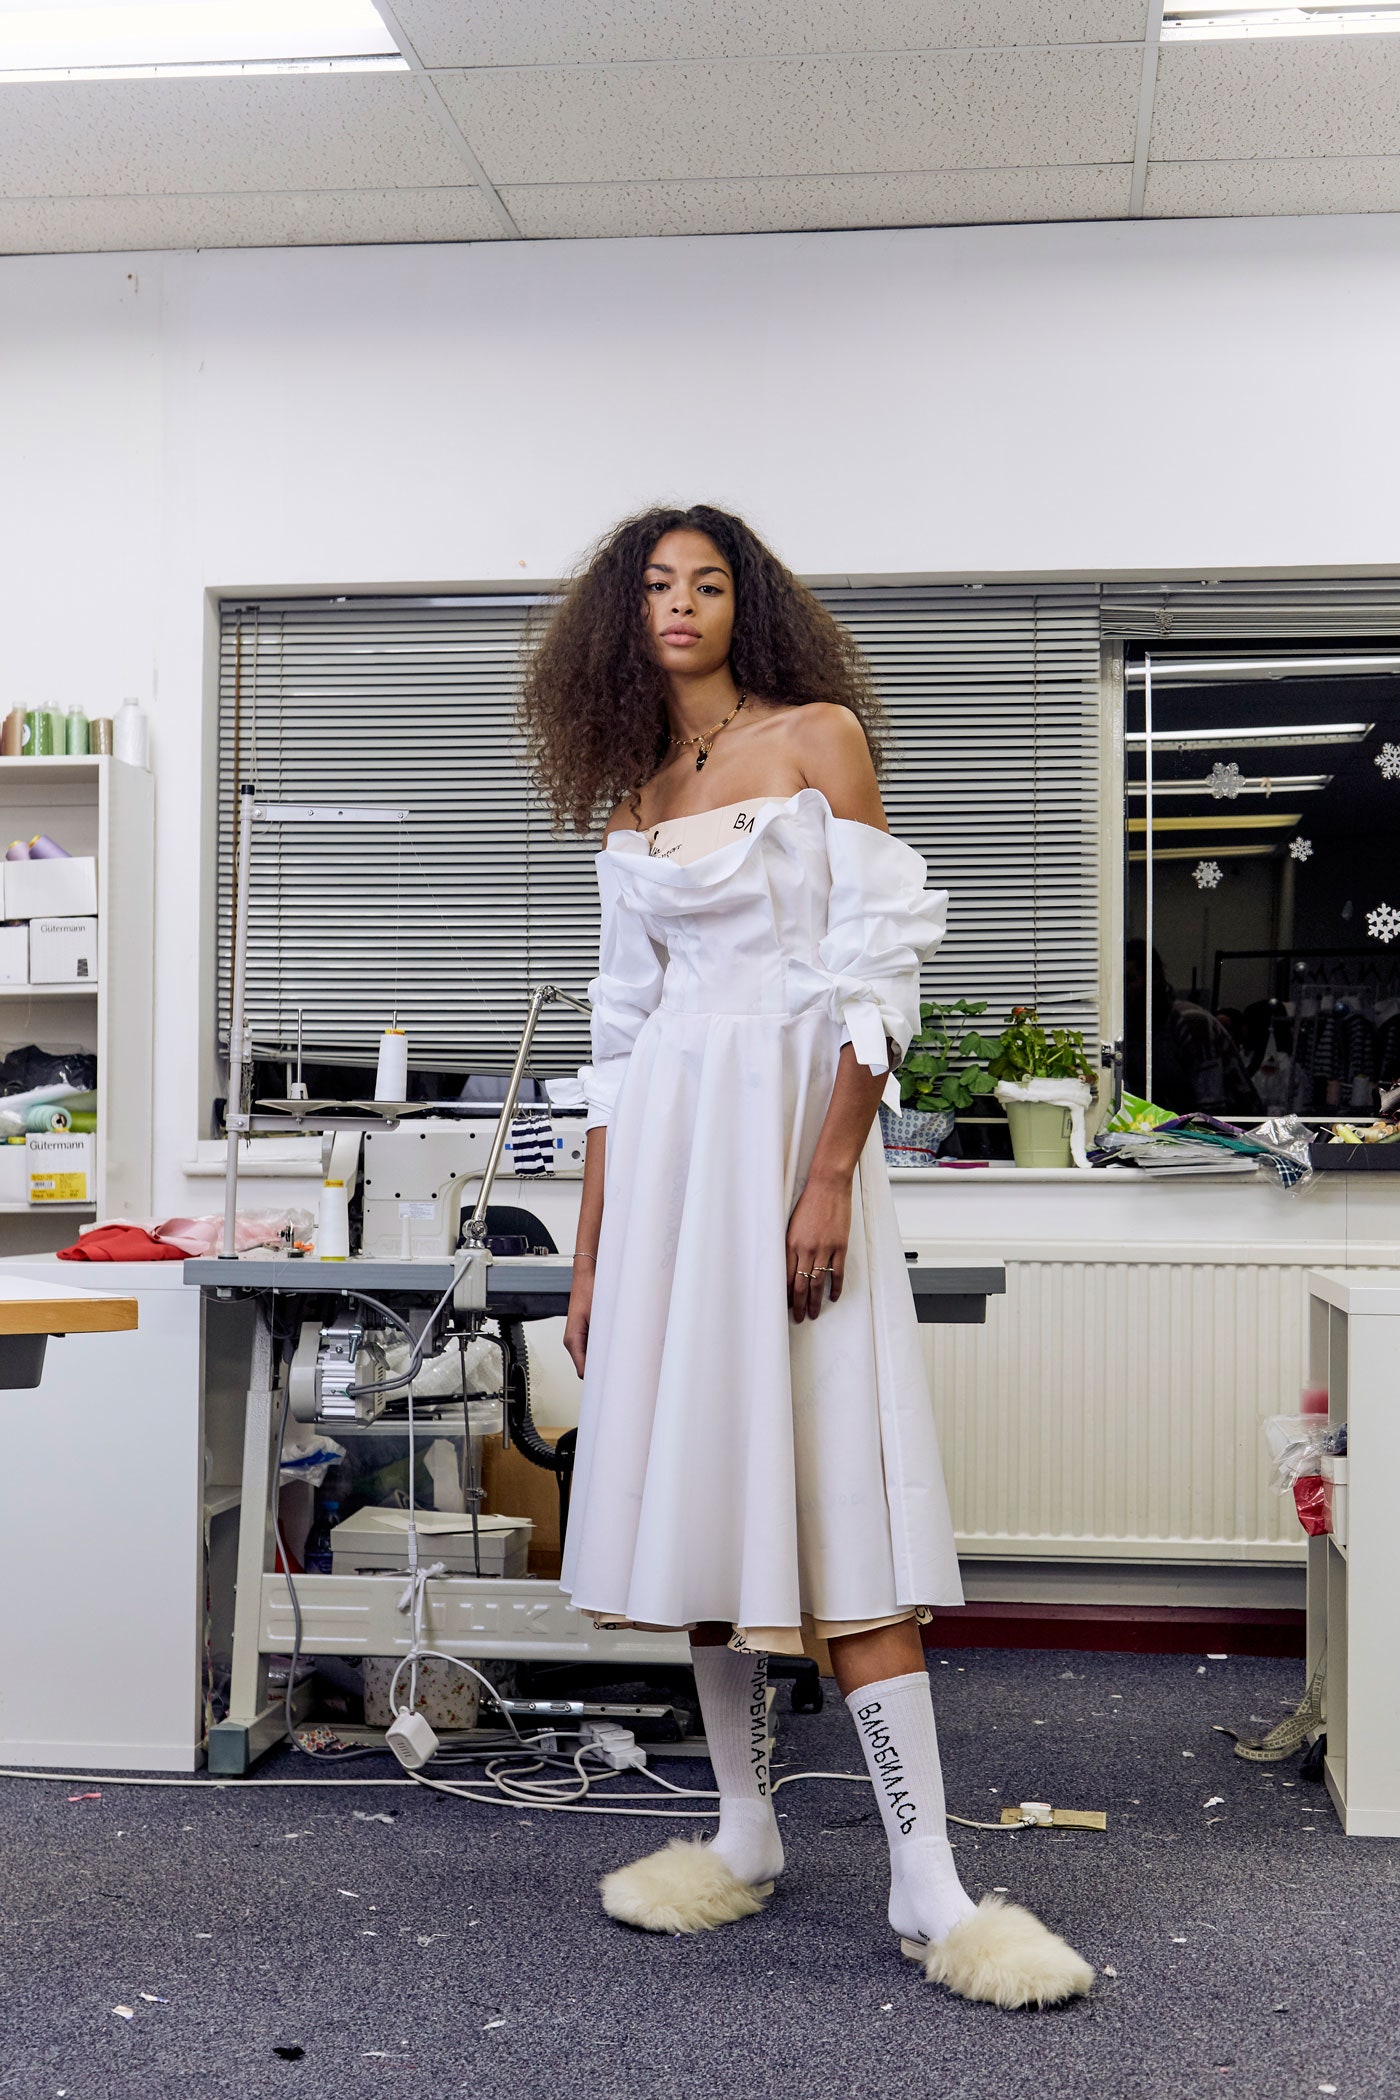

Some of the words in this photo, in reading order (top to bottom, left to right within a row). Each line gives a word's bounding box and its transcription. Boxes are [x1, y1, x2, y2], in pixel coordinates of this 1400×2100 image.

[40, 924, 86, 933] Gütermann
[29, 1140, 84, 1151] Gütermann
[857, 1701, 918, 1836] ВЛЮБИЛАСЬ
